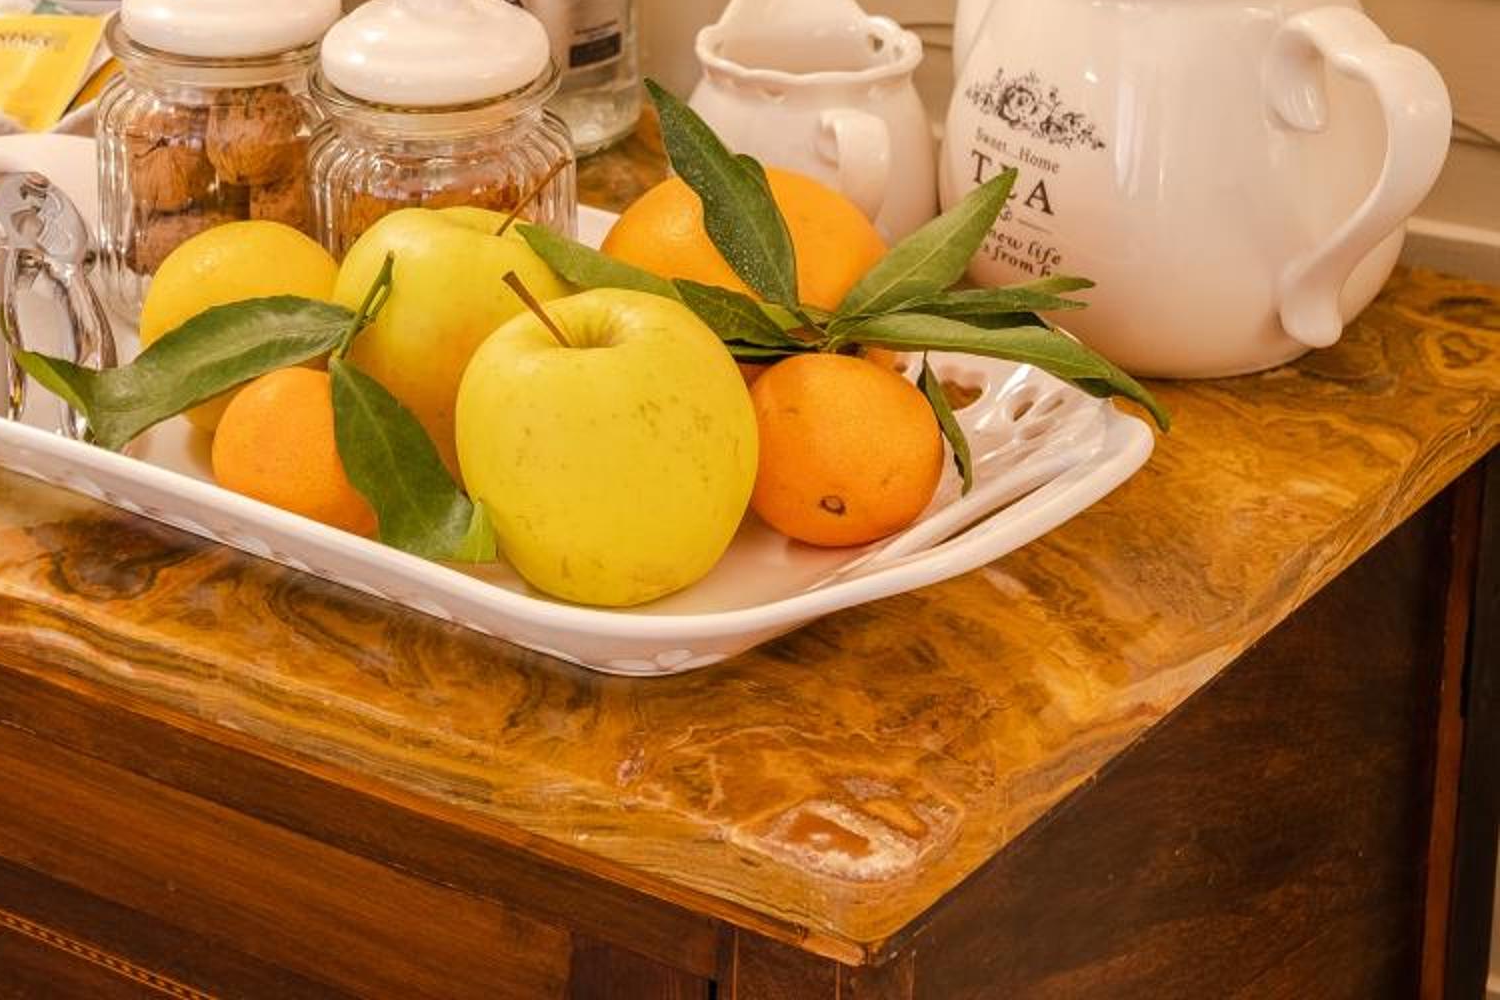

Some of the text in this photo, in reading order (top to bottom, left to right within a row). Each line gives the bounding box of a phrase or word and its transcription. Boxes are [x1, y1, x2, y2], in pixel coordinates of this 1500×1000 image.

[1019, 145, 1060, 174] Home
[971, 149, 1055, 216] TA
[991, 245, 1034, 274] from
[1027, 240, 1062, 265] life
